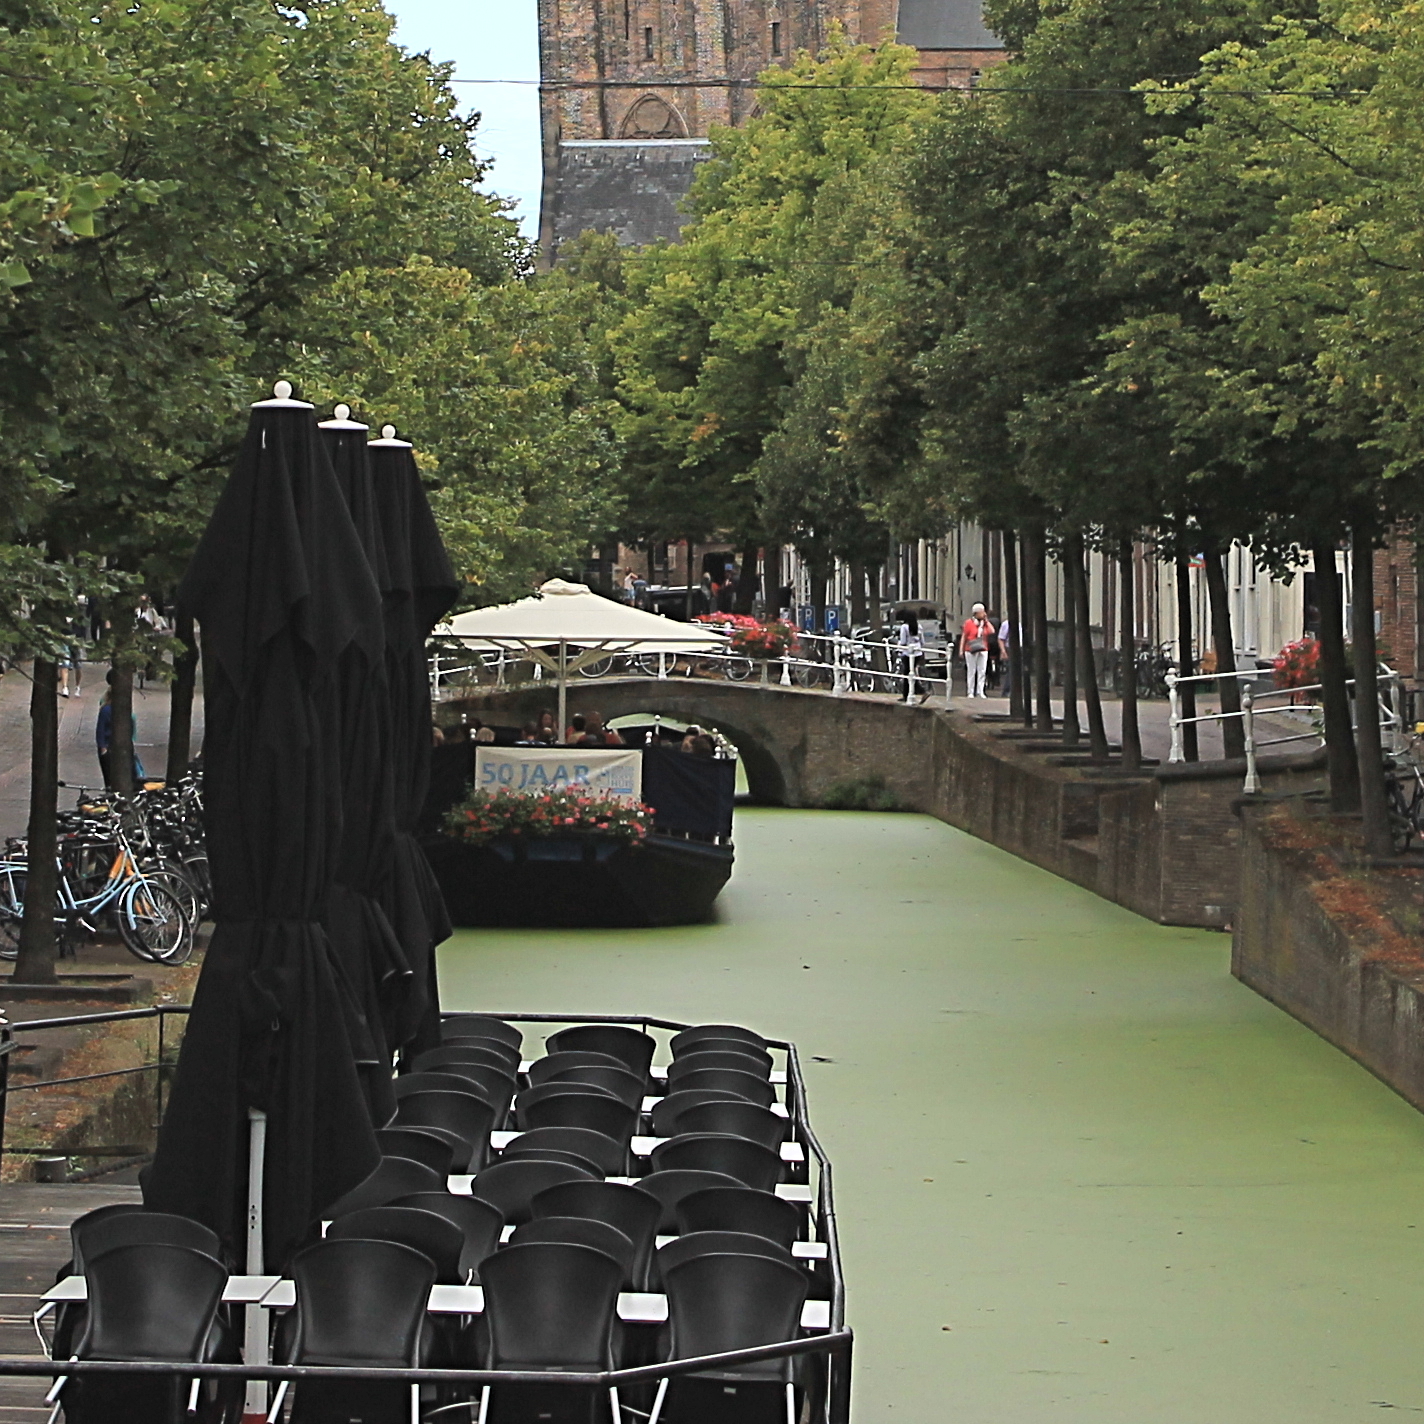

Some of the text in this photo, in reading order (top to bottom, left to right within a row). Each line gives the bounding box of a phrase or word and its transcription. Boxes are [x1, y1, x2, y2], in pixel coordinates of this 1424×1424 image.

[828, 611, 836, 624] P
[481, 762, 591, 789] 50 JAAR
